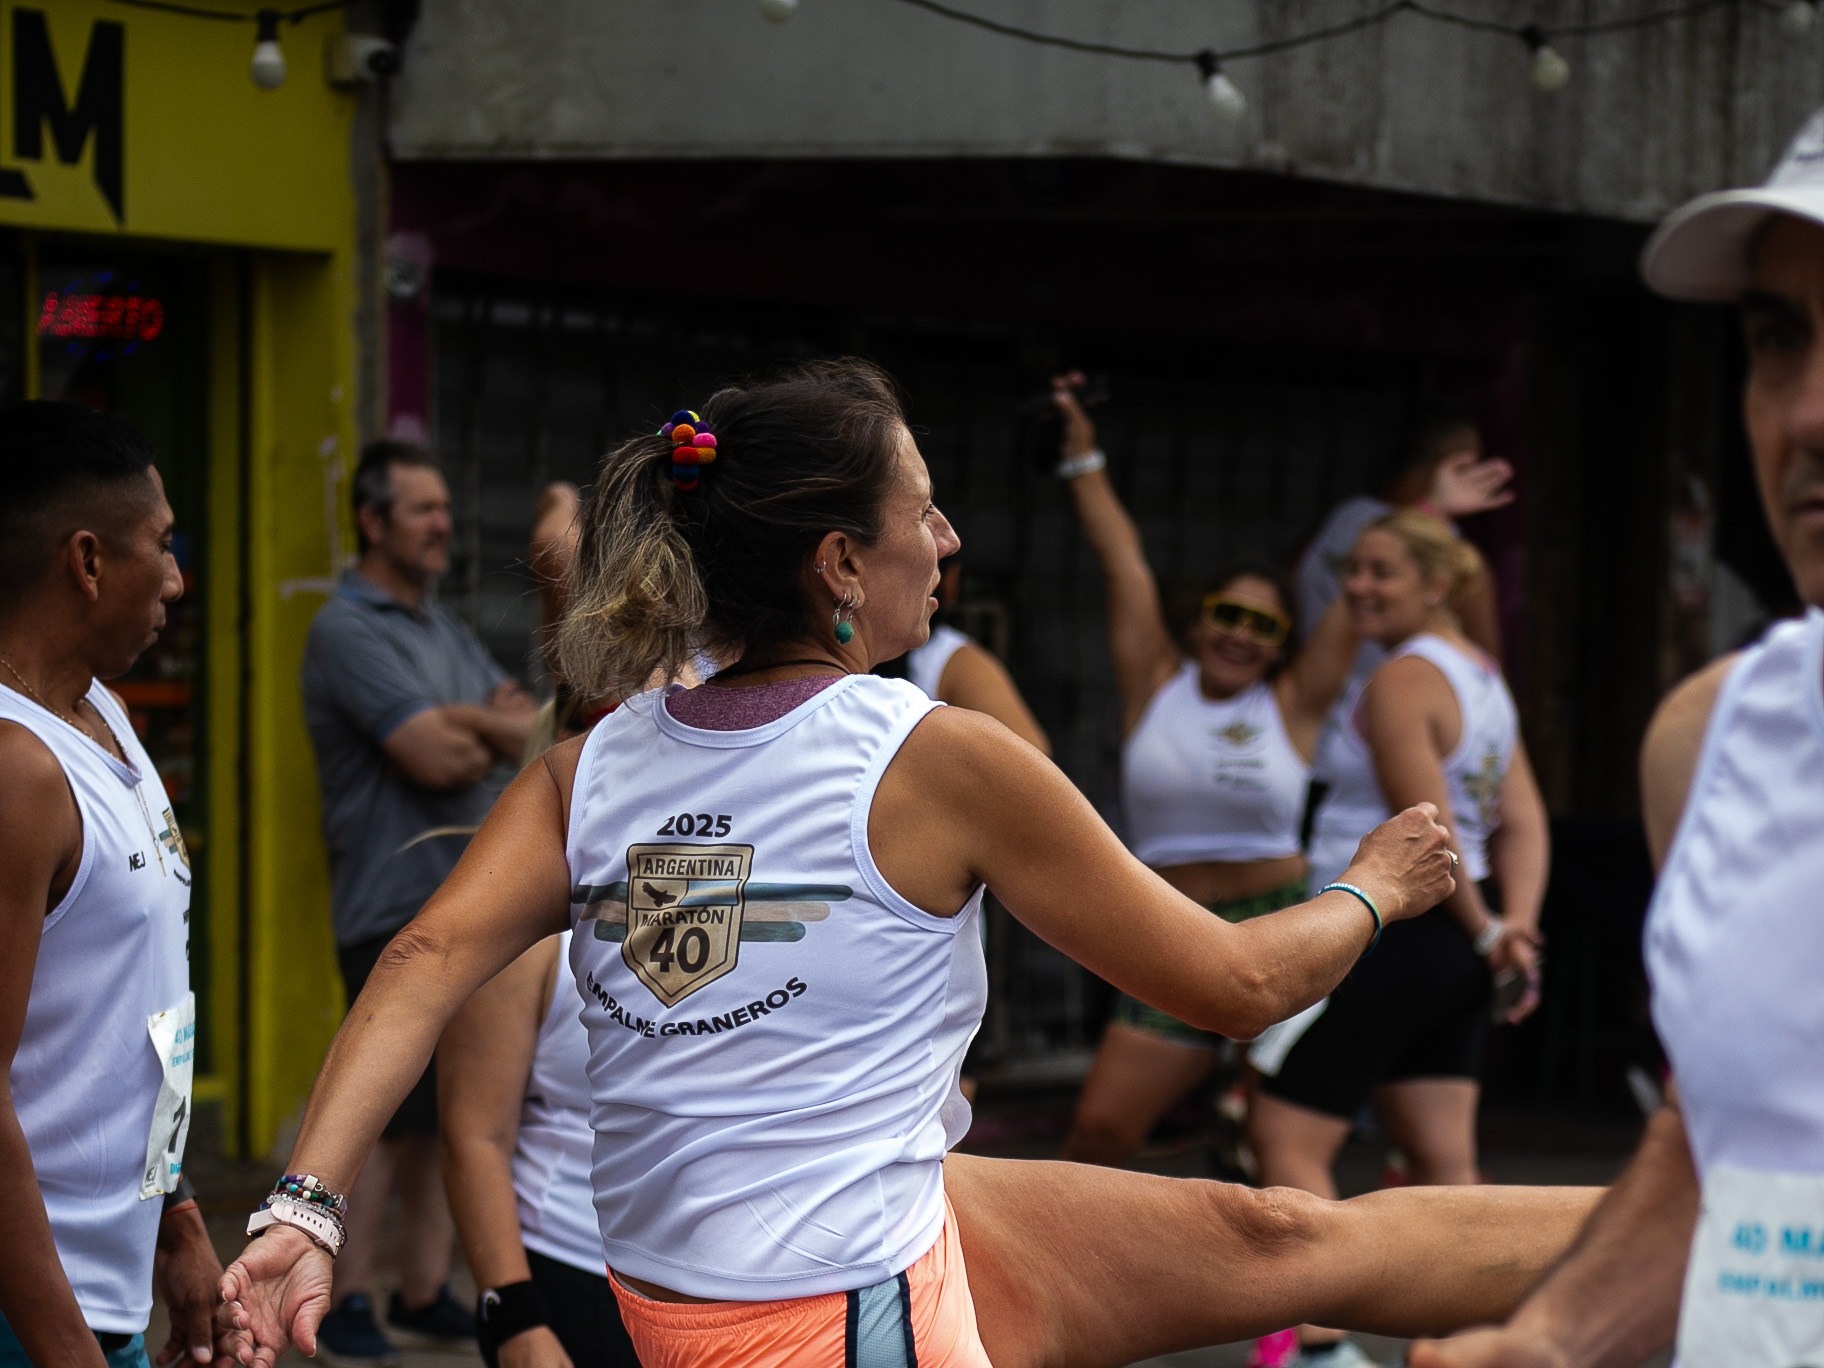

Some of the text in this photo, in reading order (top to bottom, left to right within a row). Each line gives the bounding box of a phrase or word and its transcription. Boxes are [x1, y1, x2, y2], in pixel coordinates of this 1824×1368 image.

[657, 812, 732, 838] 2025
[129, 851, 146, 873] NEJ
[643, 858, 735, 877] ARGENTINA
[642, 906, 724, 928] MARATÓN
[650, 927, 711, 974] 40
[660, 976, 808, 1038] GRANEROS
